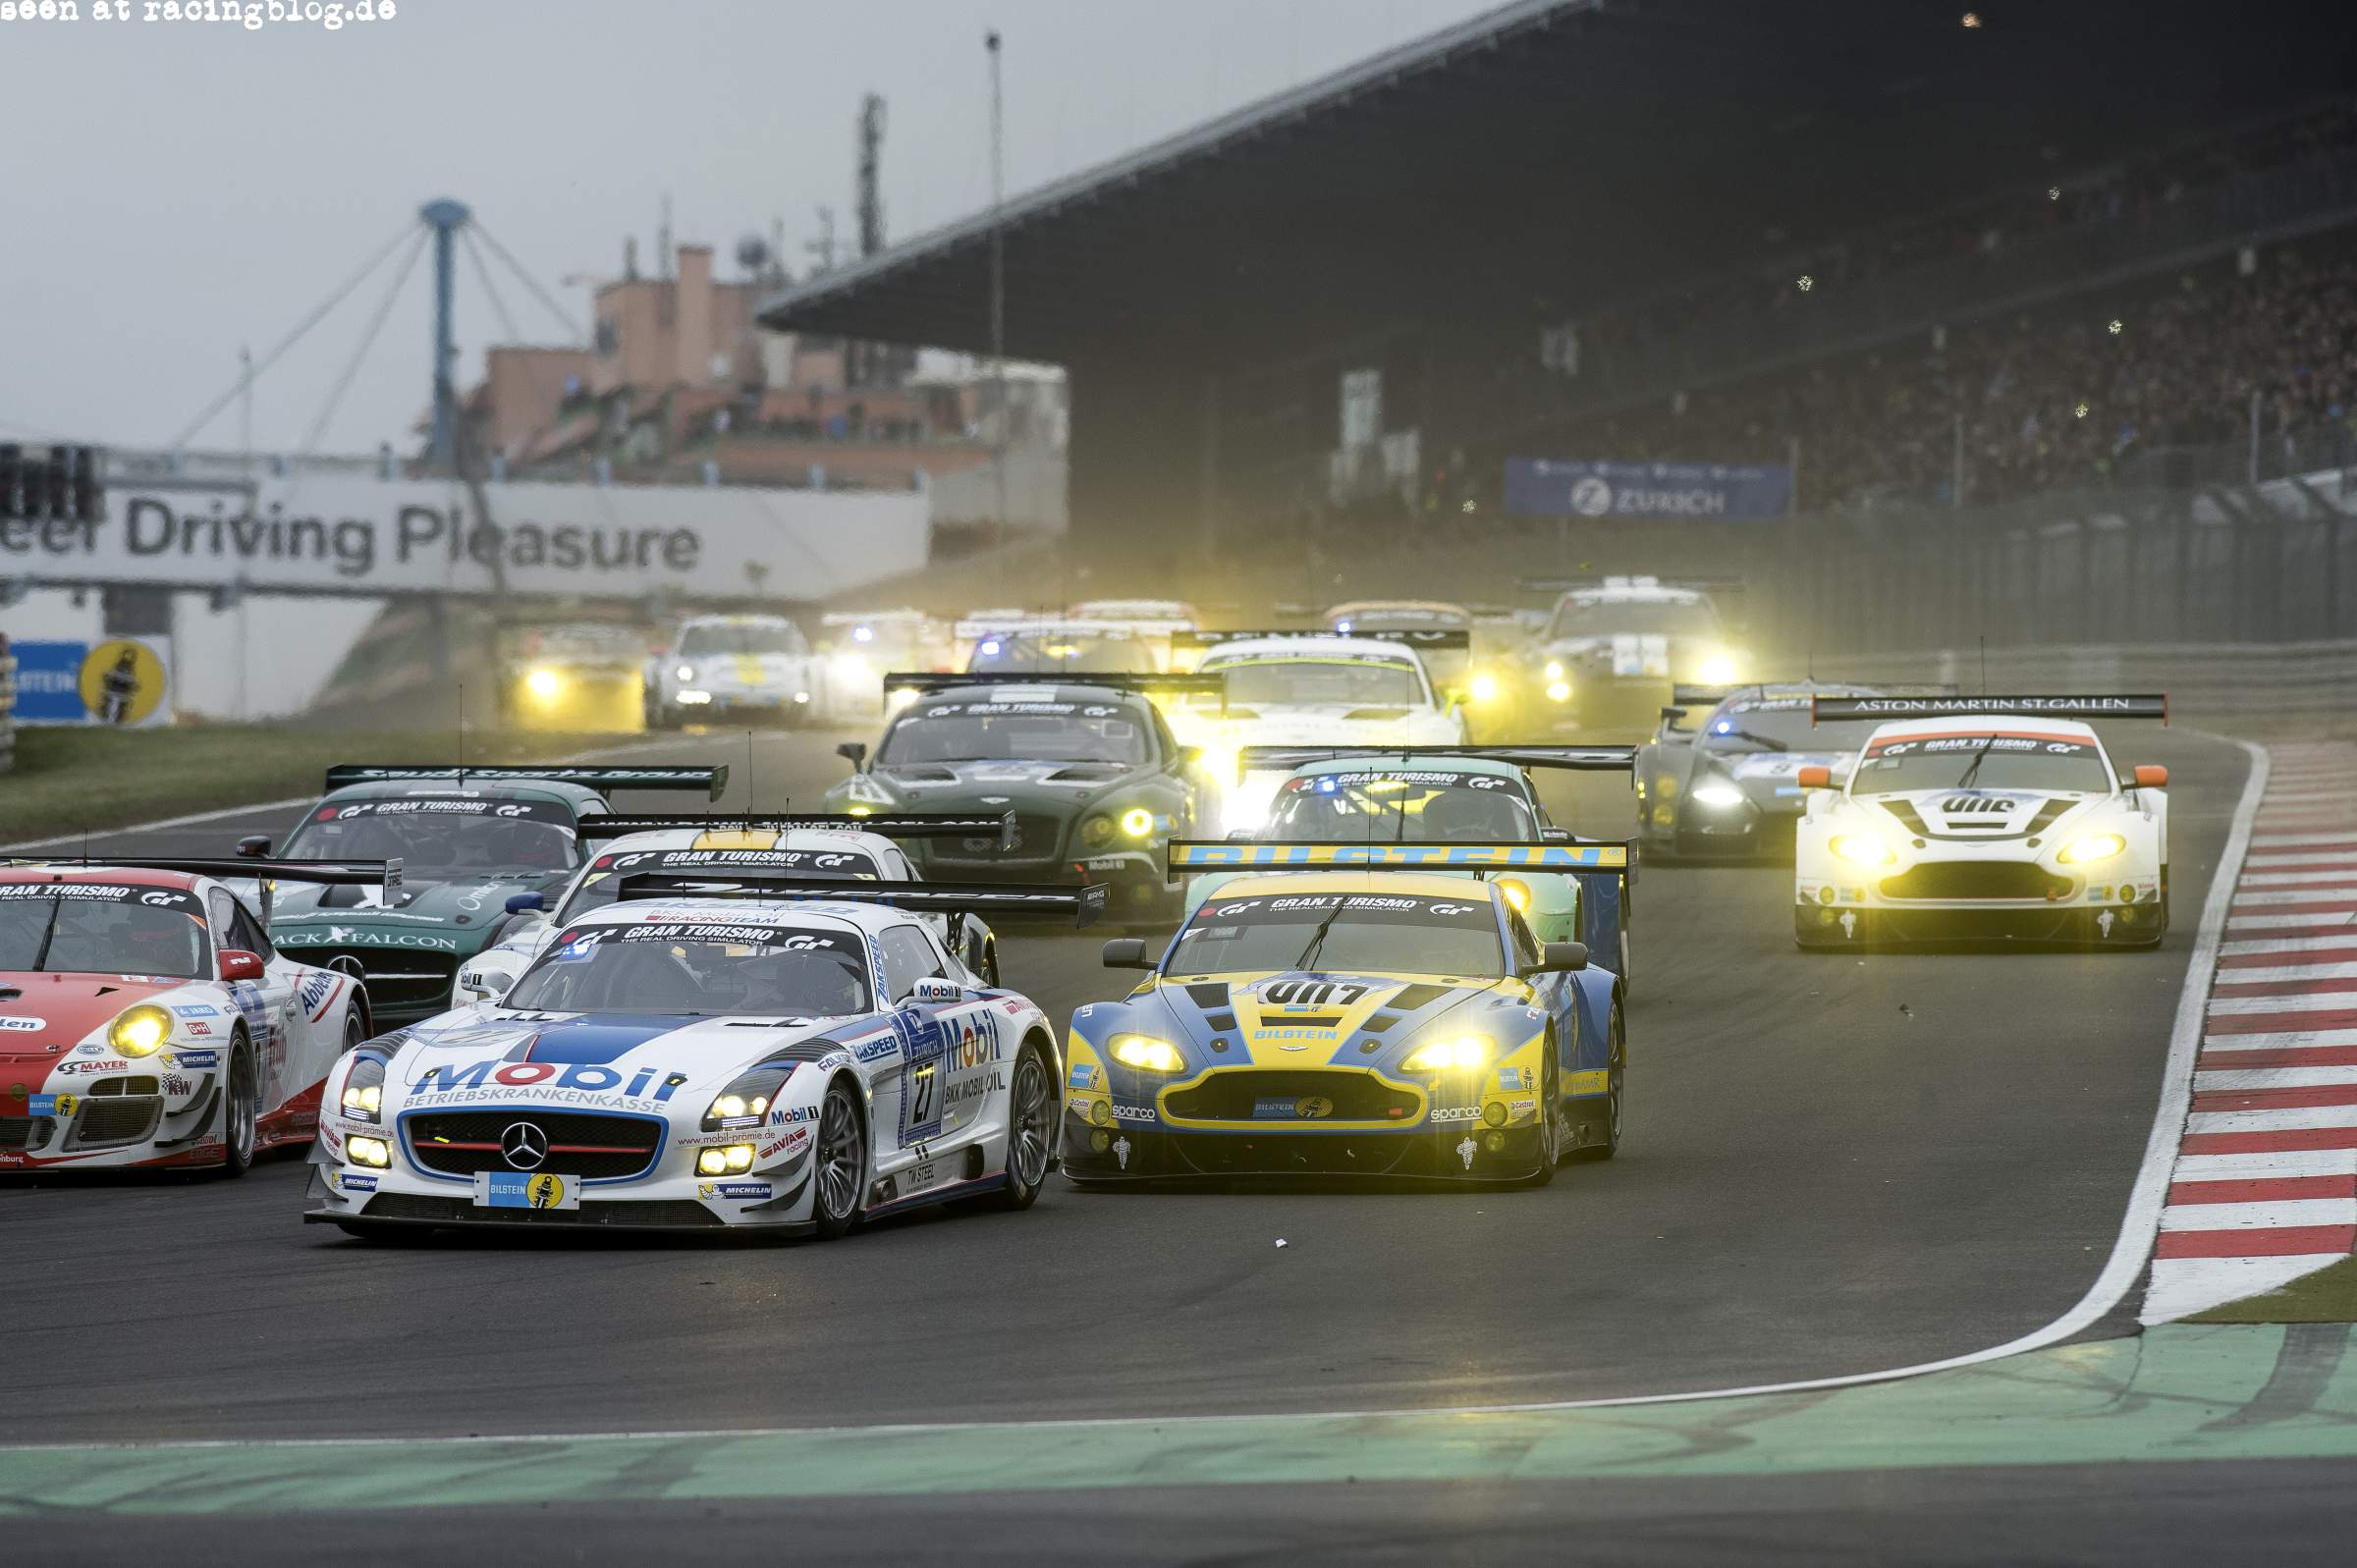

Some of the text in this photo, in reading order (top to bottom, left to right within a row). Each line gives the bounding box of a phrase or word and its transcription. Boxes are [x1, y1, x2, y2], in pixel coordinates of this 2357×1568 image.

[127, 497, 375, 575] Driving
[397, 504, 701, 570] Pleasure
[1855, 697, 2129, 711] ASTON MARTIN ST.GALLEN
[1924, 739, 1968, 749] GRAN
[1337, 772, 1382, 783] GRAN
[1387, 772, 1458, 783] TURISMO
[377, 801, 423, 813] GRAN
[423, 801, 488, 812] TURISMO
[662, 851, 711, 863] GRAN
[718, 851, 802, 863] TURISMO
[0, 885, 41, 895] RAN
[43, 885, 132, 897] TURISMO
[1271, 897, 1327, 908] GRAN
[625, 926, 679, 939] GRAN
[683, 925, 775, 941] TURISMO
[352, 932, 457, 949] FALCON
[707, 937, 763, 946] SIMULATOR
[919, 984, 954, 998] Mobil
[940, 1008, 1001, 1073] Mobil
[1254, 1030, 1337, 1040] BILSTEIN
[81, 1060, 128, 1071] MAYER
[411, 1057, 686, 1102] Mobil
[912, 1062, 935, 1124] 27
[945, 1072, 1006, 1105] BKK MOBIL OIL
[403, 1087, 666, 1114] BETRIEBSKRANKENKASSE
[771, 1108, 806, 1124] Mobil
[1112, 1105, 1156, 1119] sparco
[1430, 1107, 1482, 1122] sparco
[678, 1129, 776, 1147] www.mobil-prämie.de
[772, 1132, 797, 1155] AVIA
[787, 1138, 809, 1155] racing
[491, 1185, 525, 1195] BILSTEIN
